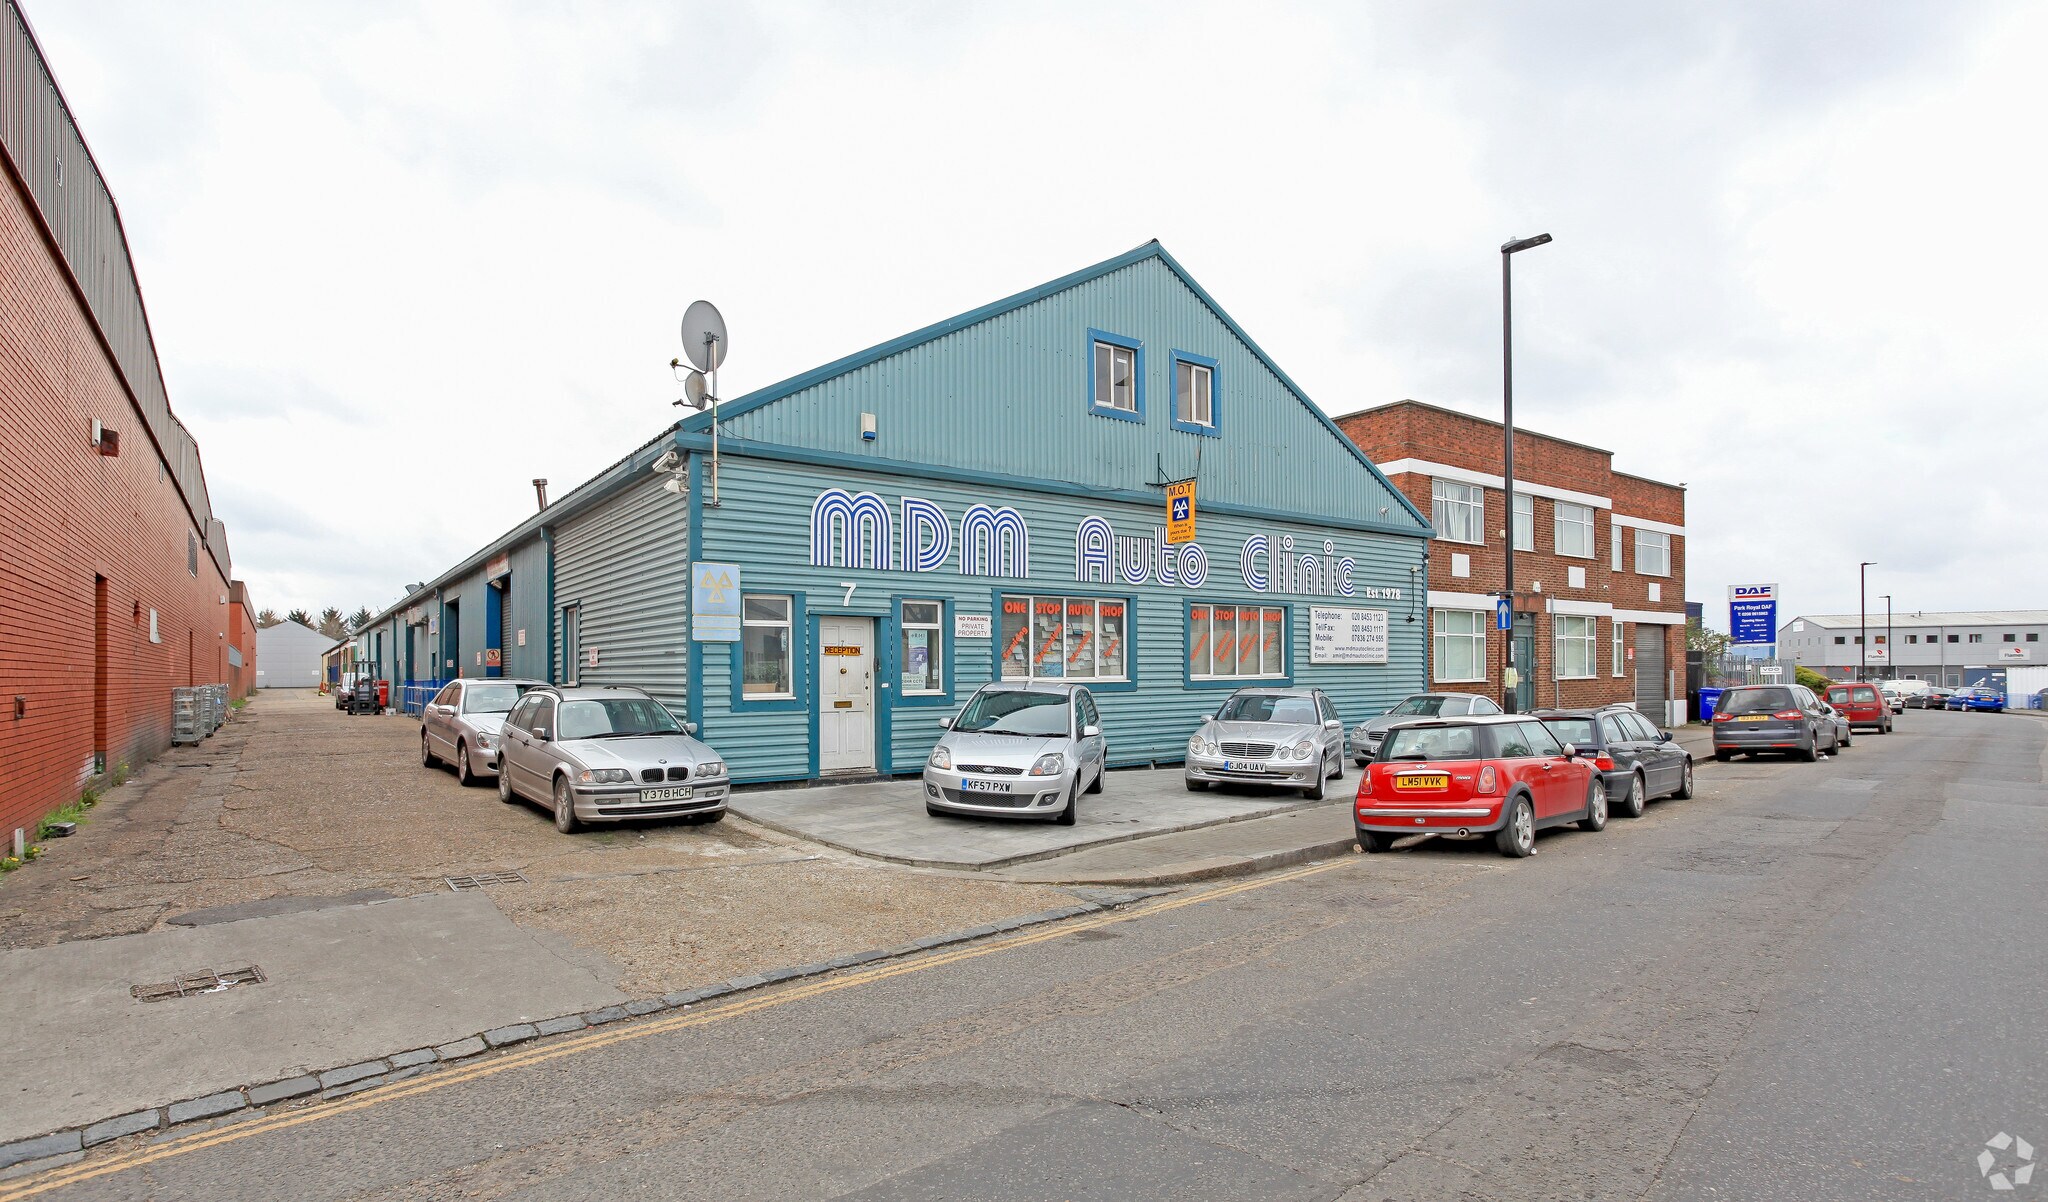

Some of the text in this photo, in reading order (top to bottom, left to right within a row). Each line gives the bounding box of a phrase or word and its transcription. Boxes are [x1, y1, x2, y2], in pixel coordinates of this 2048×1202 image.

[1169, 483, 1192, 497] M.O.T
[810, 487, 1356, 598] MDM Auto Clinic
[840, 582, 857, 607] 7
[1366, 586, 1401, 601] Est 1978
[1735, 586, 1771, 595] DAF
[1003, 601, 1123, 617] ONE STOP AUTO SHOP
[1191, 609, 1281, 622] ONE STOP AUTO SHOP
[1314, 610, 1384, 622] Telephone: 020 8453 1123
[1361, 625, 1373, 633] 8453
[1315, 634, 1334, 642] Mobile:
[824, 646, 860, 654] RECEPTION
[1228, 761, 1265, 771] GJ04 UAV
[968, 781, 1011, 792] KF57 PXW
[1402, 777, 1442, 786] LM51 VVK
[643, 787, 691, 799] Y378 HCH
